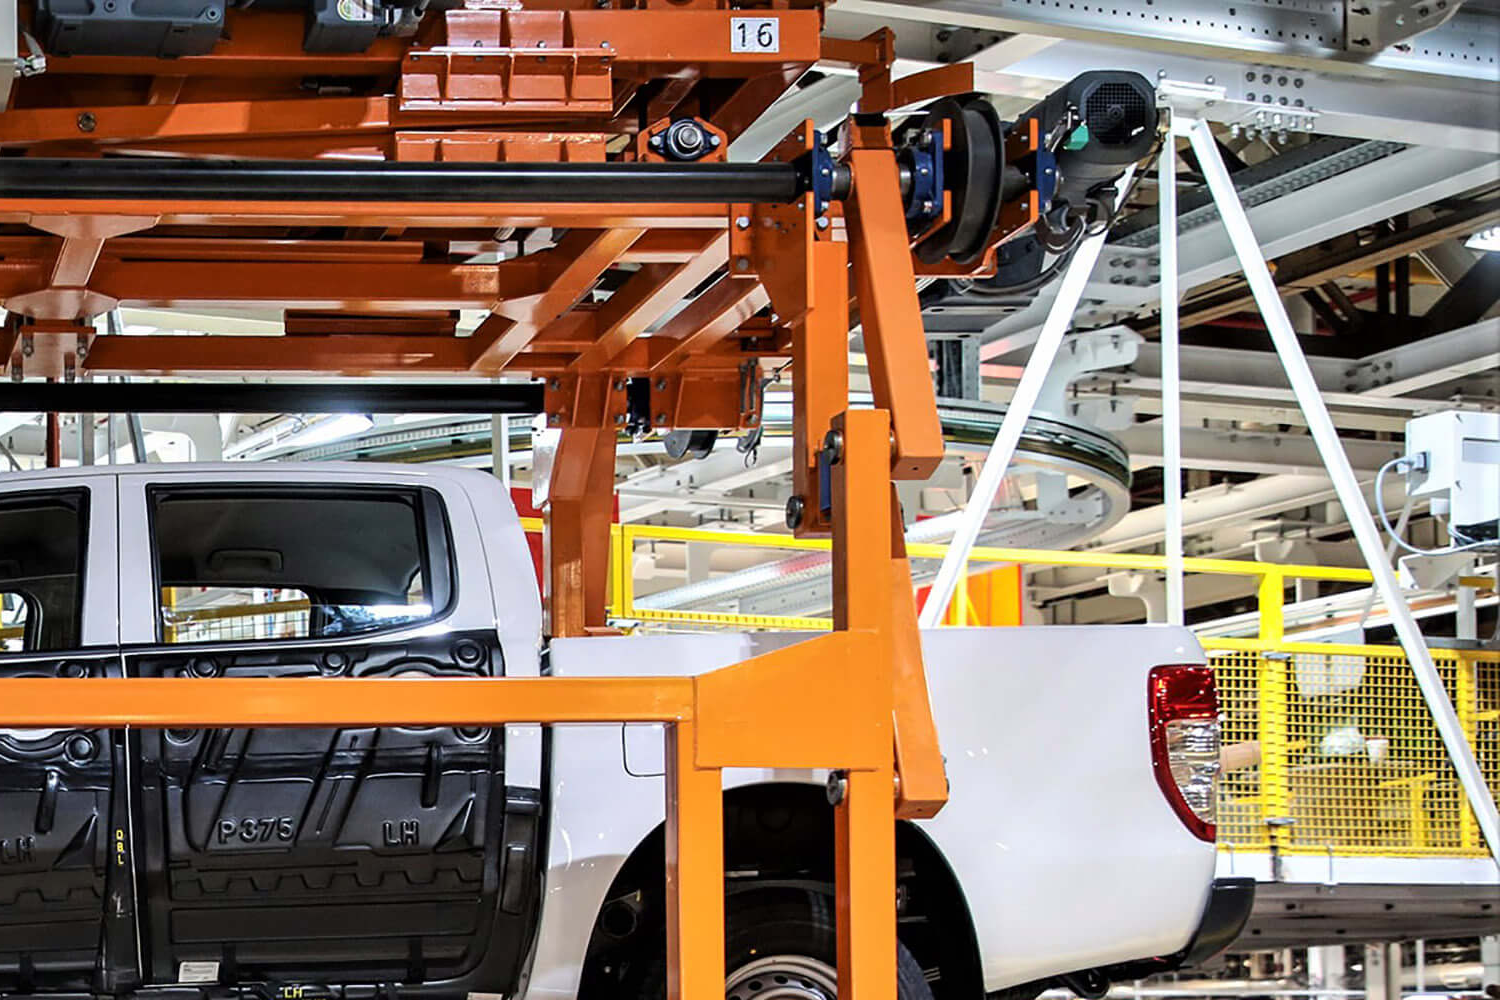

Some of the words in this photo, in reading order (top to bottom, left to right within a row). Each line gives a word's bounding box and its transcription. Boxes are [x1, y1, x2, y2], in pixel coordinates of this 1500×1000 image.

[737, 22, 773, 48] 16
[217, 817, 294, 845] P375
[381, 818, 420, 847] LH
